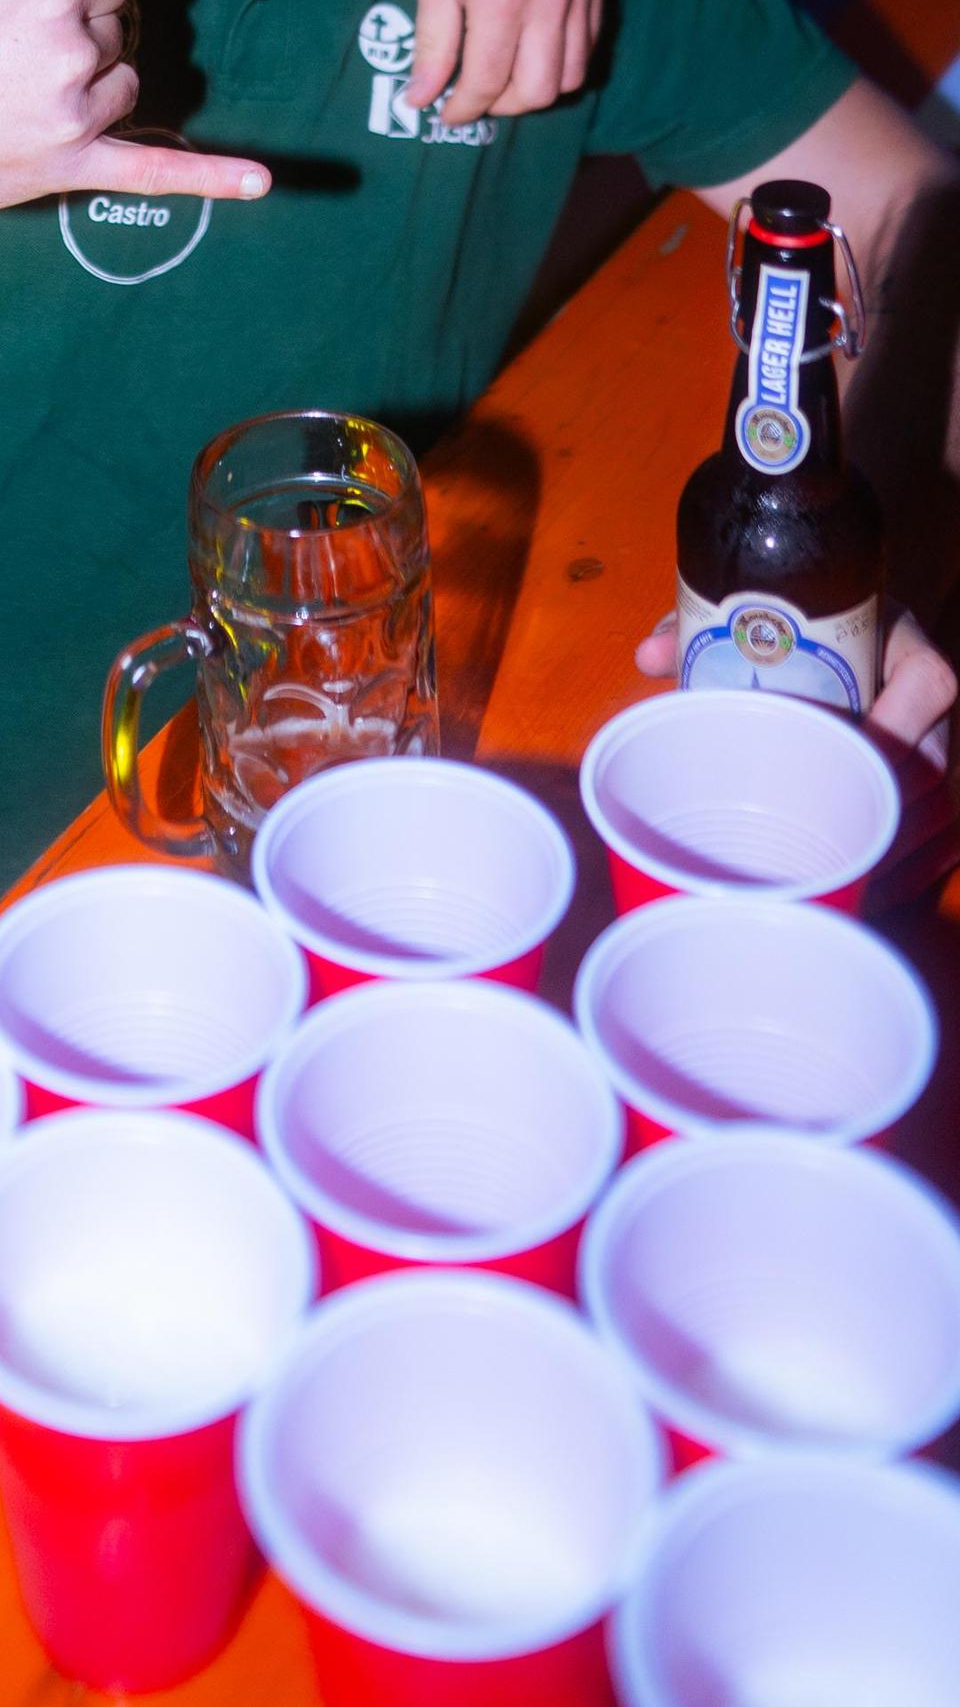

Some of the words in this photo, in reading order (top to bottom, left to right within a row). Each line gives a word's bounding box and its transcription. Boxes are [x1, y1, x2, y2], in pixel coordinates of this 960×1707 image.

[88, 196, 170, 227] Castro
[766, 284, 798, 337] HELL
[760, 338, 792, 405] LAGER
